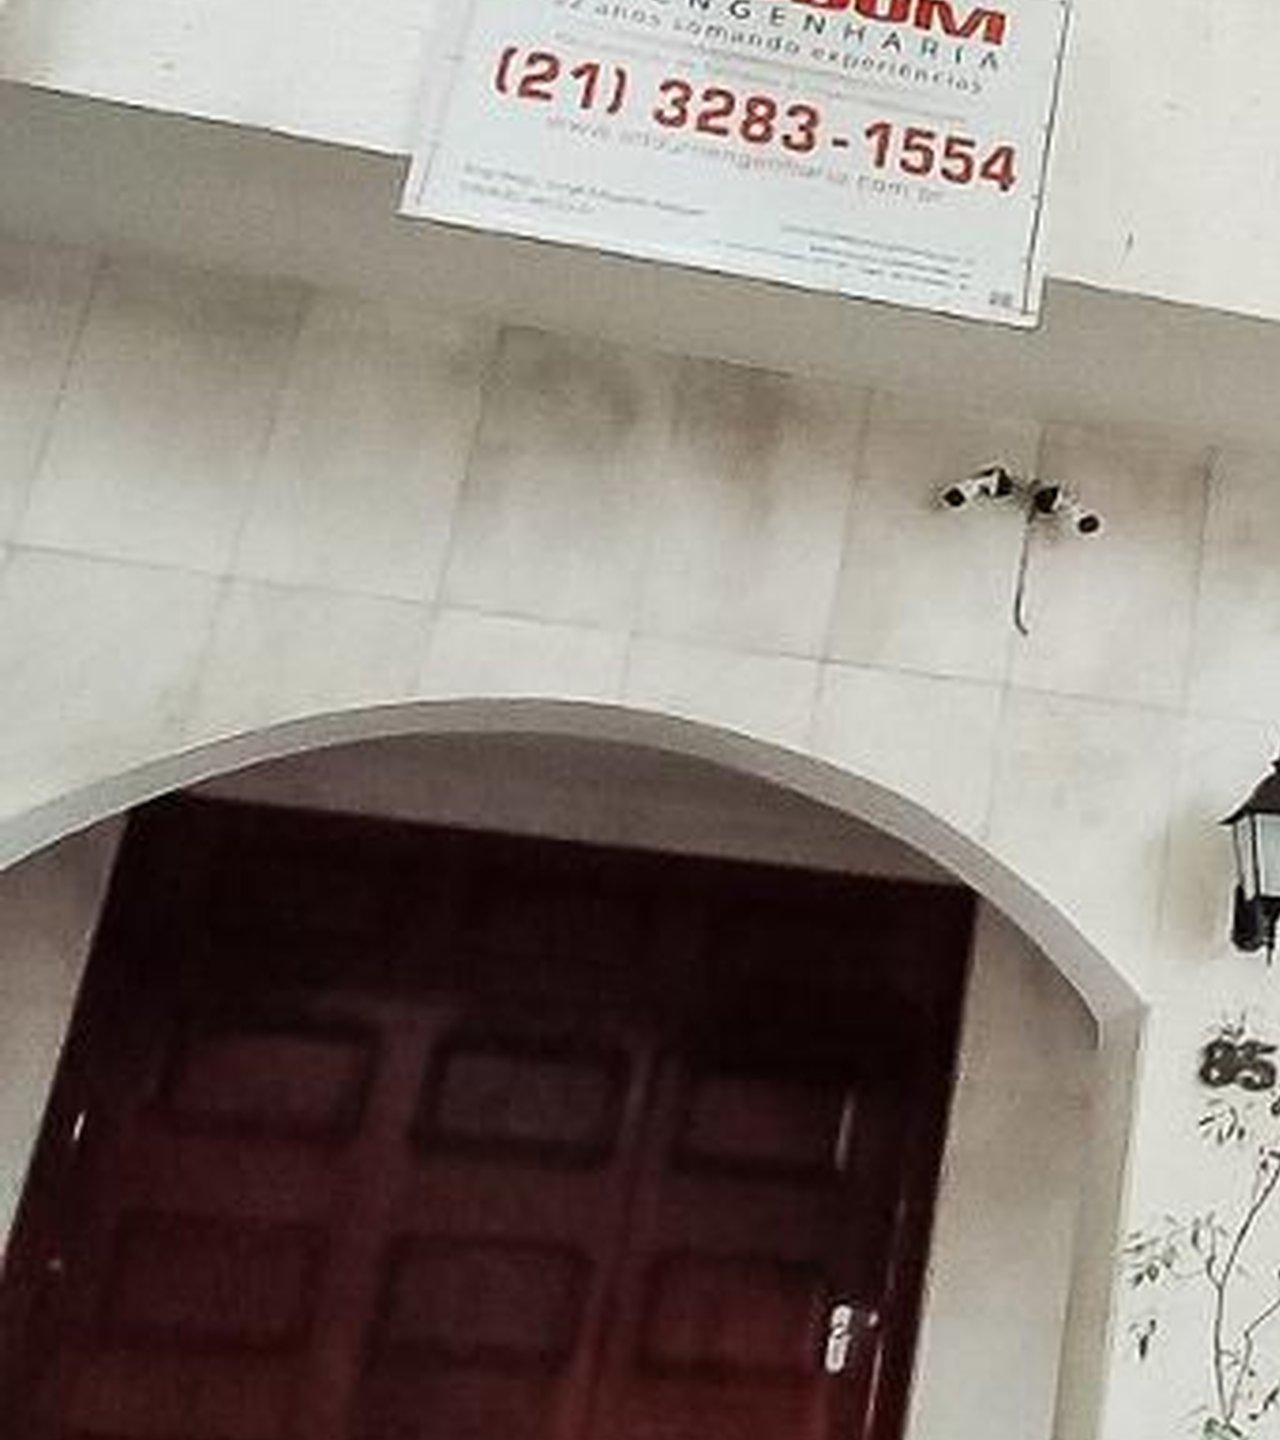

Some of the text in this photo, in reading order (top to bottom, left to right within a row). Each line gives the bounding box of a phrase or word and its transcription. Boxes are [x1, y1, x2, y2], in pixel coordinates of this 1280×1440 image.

[595, 3, 661, 28] anos
[673, 19, 800, 56] somando
[493, 46, 627, 114] (21)
[1199, 1038, 1279, 1091] 85
